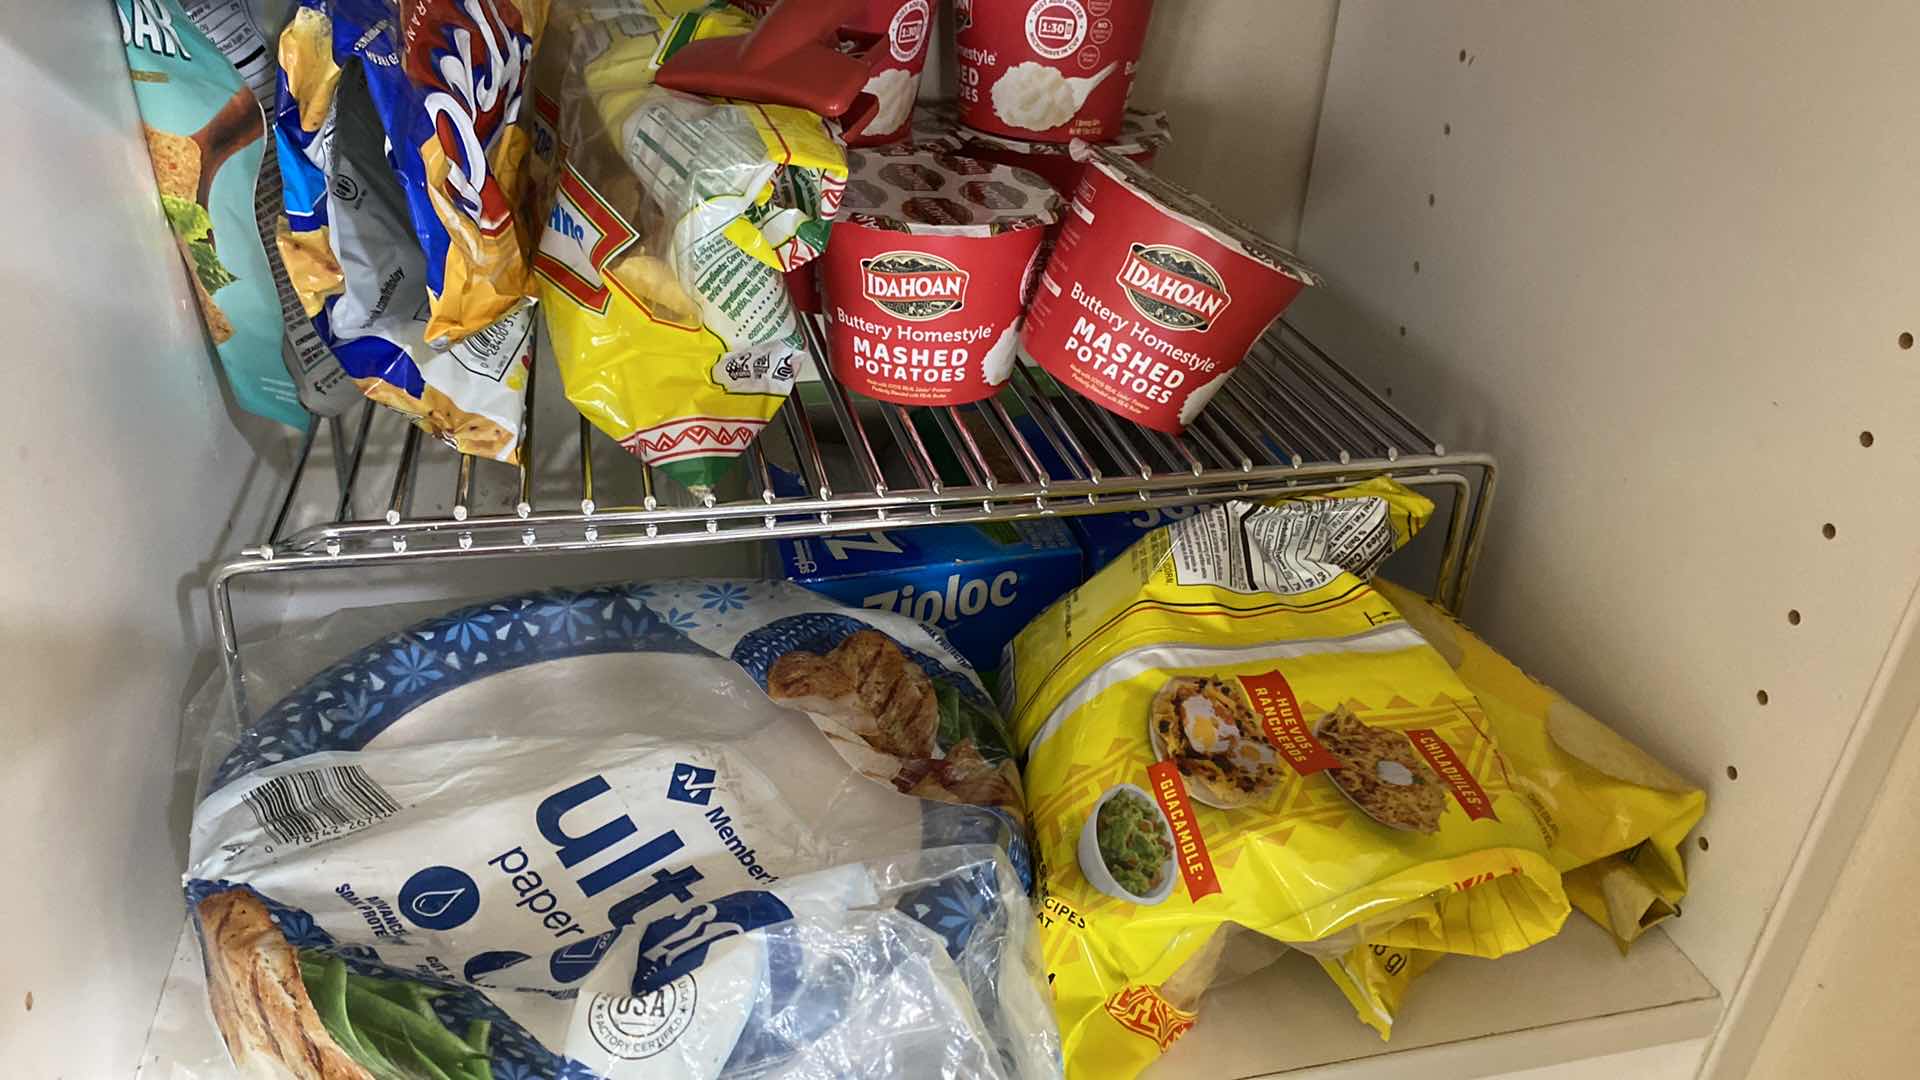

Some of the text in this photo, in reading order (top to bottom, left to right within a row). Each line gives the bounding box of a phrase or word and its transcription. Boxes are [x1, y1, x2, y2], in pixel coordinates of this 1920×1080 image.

[1042, 22, 1064, 34] 1:30
[867, 273, 962, 297] IDAHOAN
[1071, 282, 1129, 331] Buttery
[1124, 258, 1222, 318] IDAHOAN
[487, 327, 508, 356] 28400
[837, 307, 892, 340] Buttery
[853, 336, 968, 368] MASHED
[854, 356, 966, 383] POTATOES
[1065, 337, 1173, 404] POTATOES
[1073, 317, 1185, 389] MASHED
[862, 570, 1018, 627] Ziploc
[1255, 687, 1307, 762] RANCHEROS
[1276, 697, 1312, 750] HUEVOS
[1420, 736, 1482, 806] CHILAQUILES
[294, 826, 341, 846] 78742
[1160, 778, 1204, 875] GUACAMOLE
[488, 846, 584, 938] paper
[595, 1013, 683, 1053] FACTORY CERTIFIED
